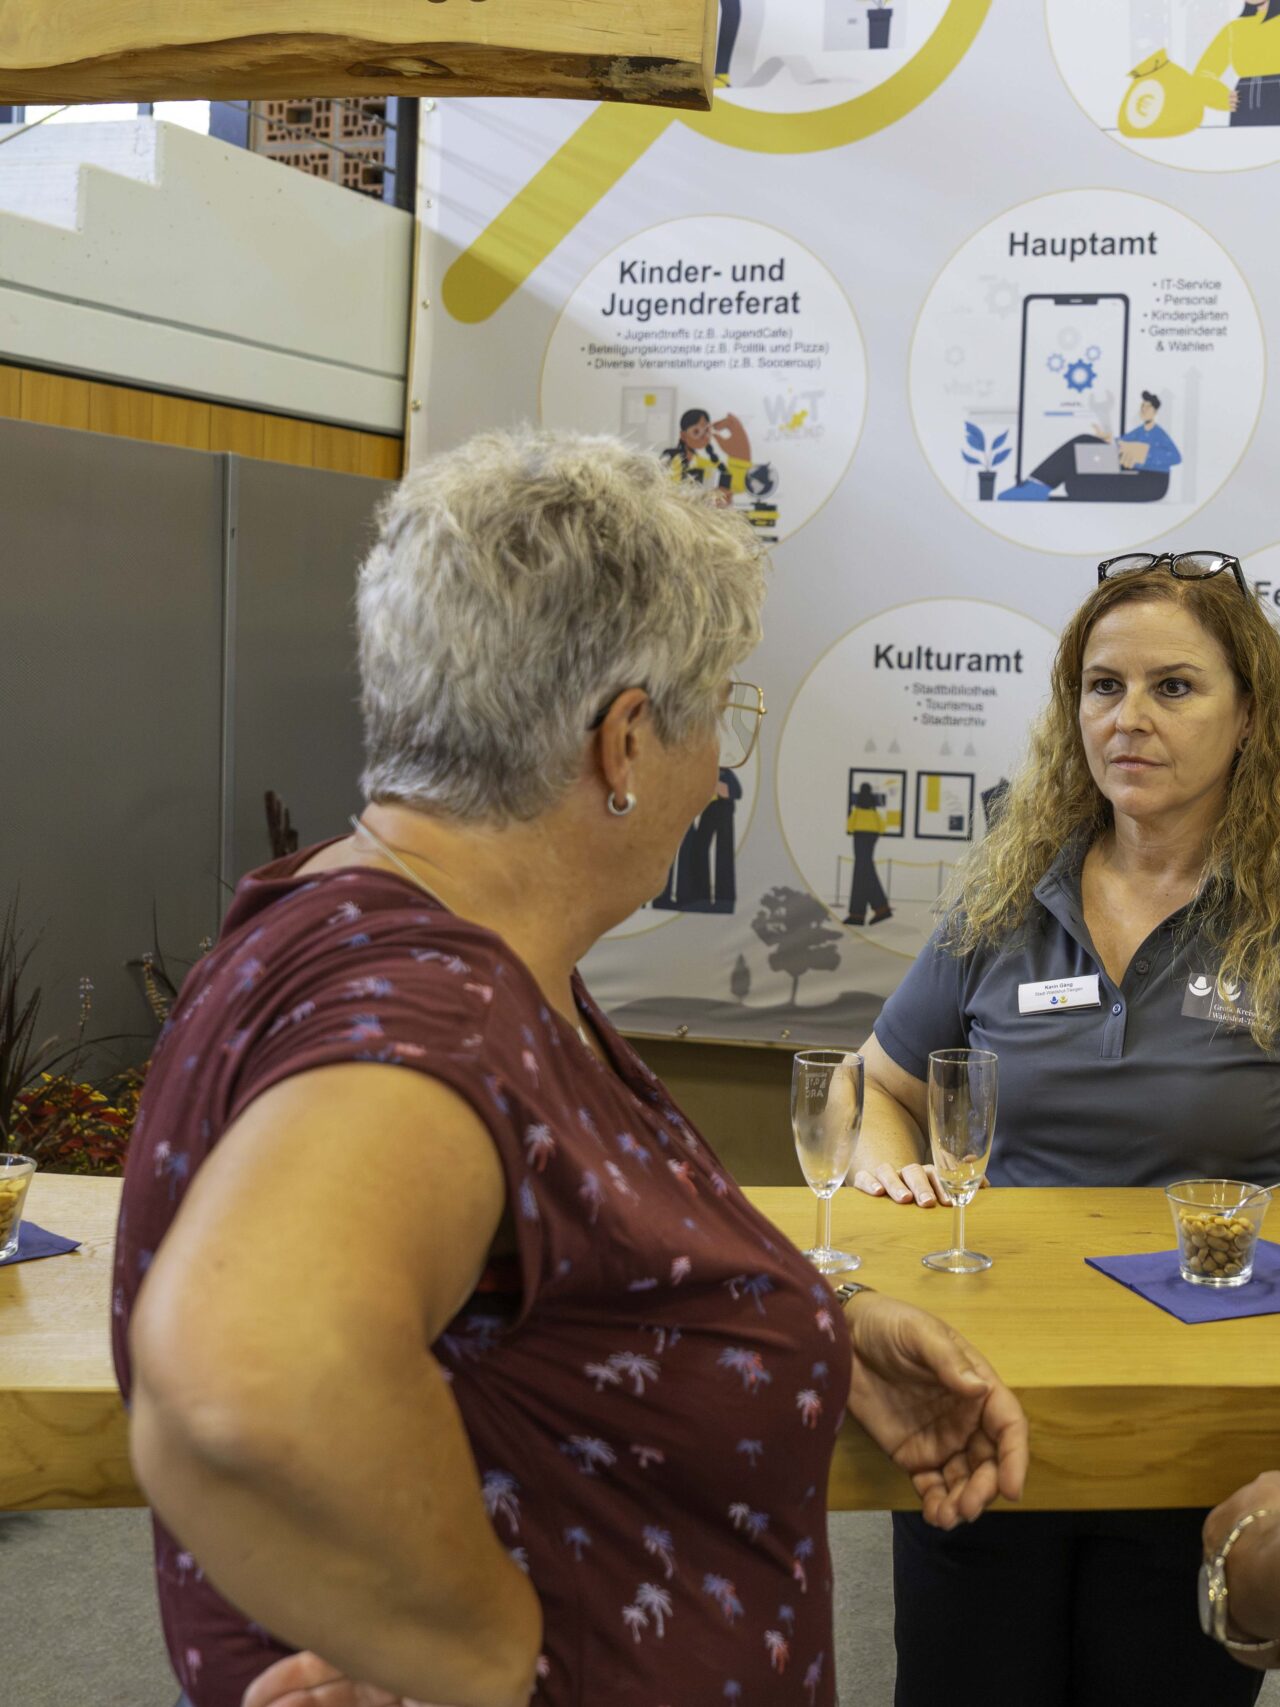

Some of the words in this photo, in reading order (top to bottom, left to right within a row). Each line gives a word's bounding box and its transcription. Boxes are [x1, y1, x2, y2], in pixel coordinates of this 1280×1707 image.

[1009, 231, 1158, 262] Hauptamt
[619, 259, 722, 285] Kinder-
[732, 258, 785, 282] und
[1160, 278, 1222, 291] IT-Service
[602, 290, 801, 323] Jugendreferat
[1163, 293, 1218, 306] Personal
[1150, 309, 1229, 324] Kindergärten
[623, 328, 690, 342] Jugendtreffs
[1147, 324, 1228, 337] Gemeinderat
[587, 342, 702, 357] Beteiligungskonzepte
[769, 341, 791, 353] und
[1155, 340, 1165, 352] &
[1168, 340, 1215, 353] Wahlen
[594, 357, 636, 370] Diverse
[639, 357, 726, 371] Veranstaltungen
[873, 643, 1024, 674] Kulturamt
[911, 682, 998, 698] Stadtbibliothek
[925, 698, 984, 712] Tourismus
[920, 713, 987, 728] Stadtarchiv
